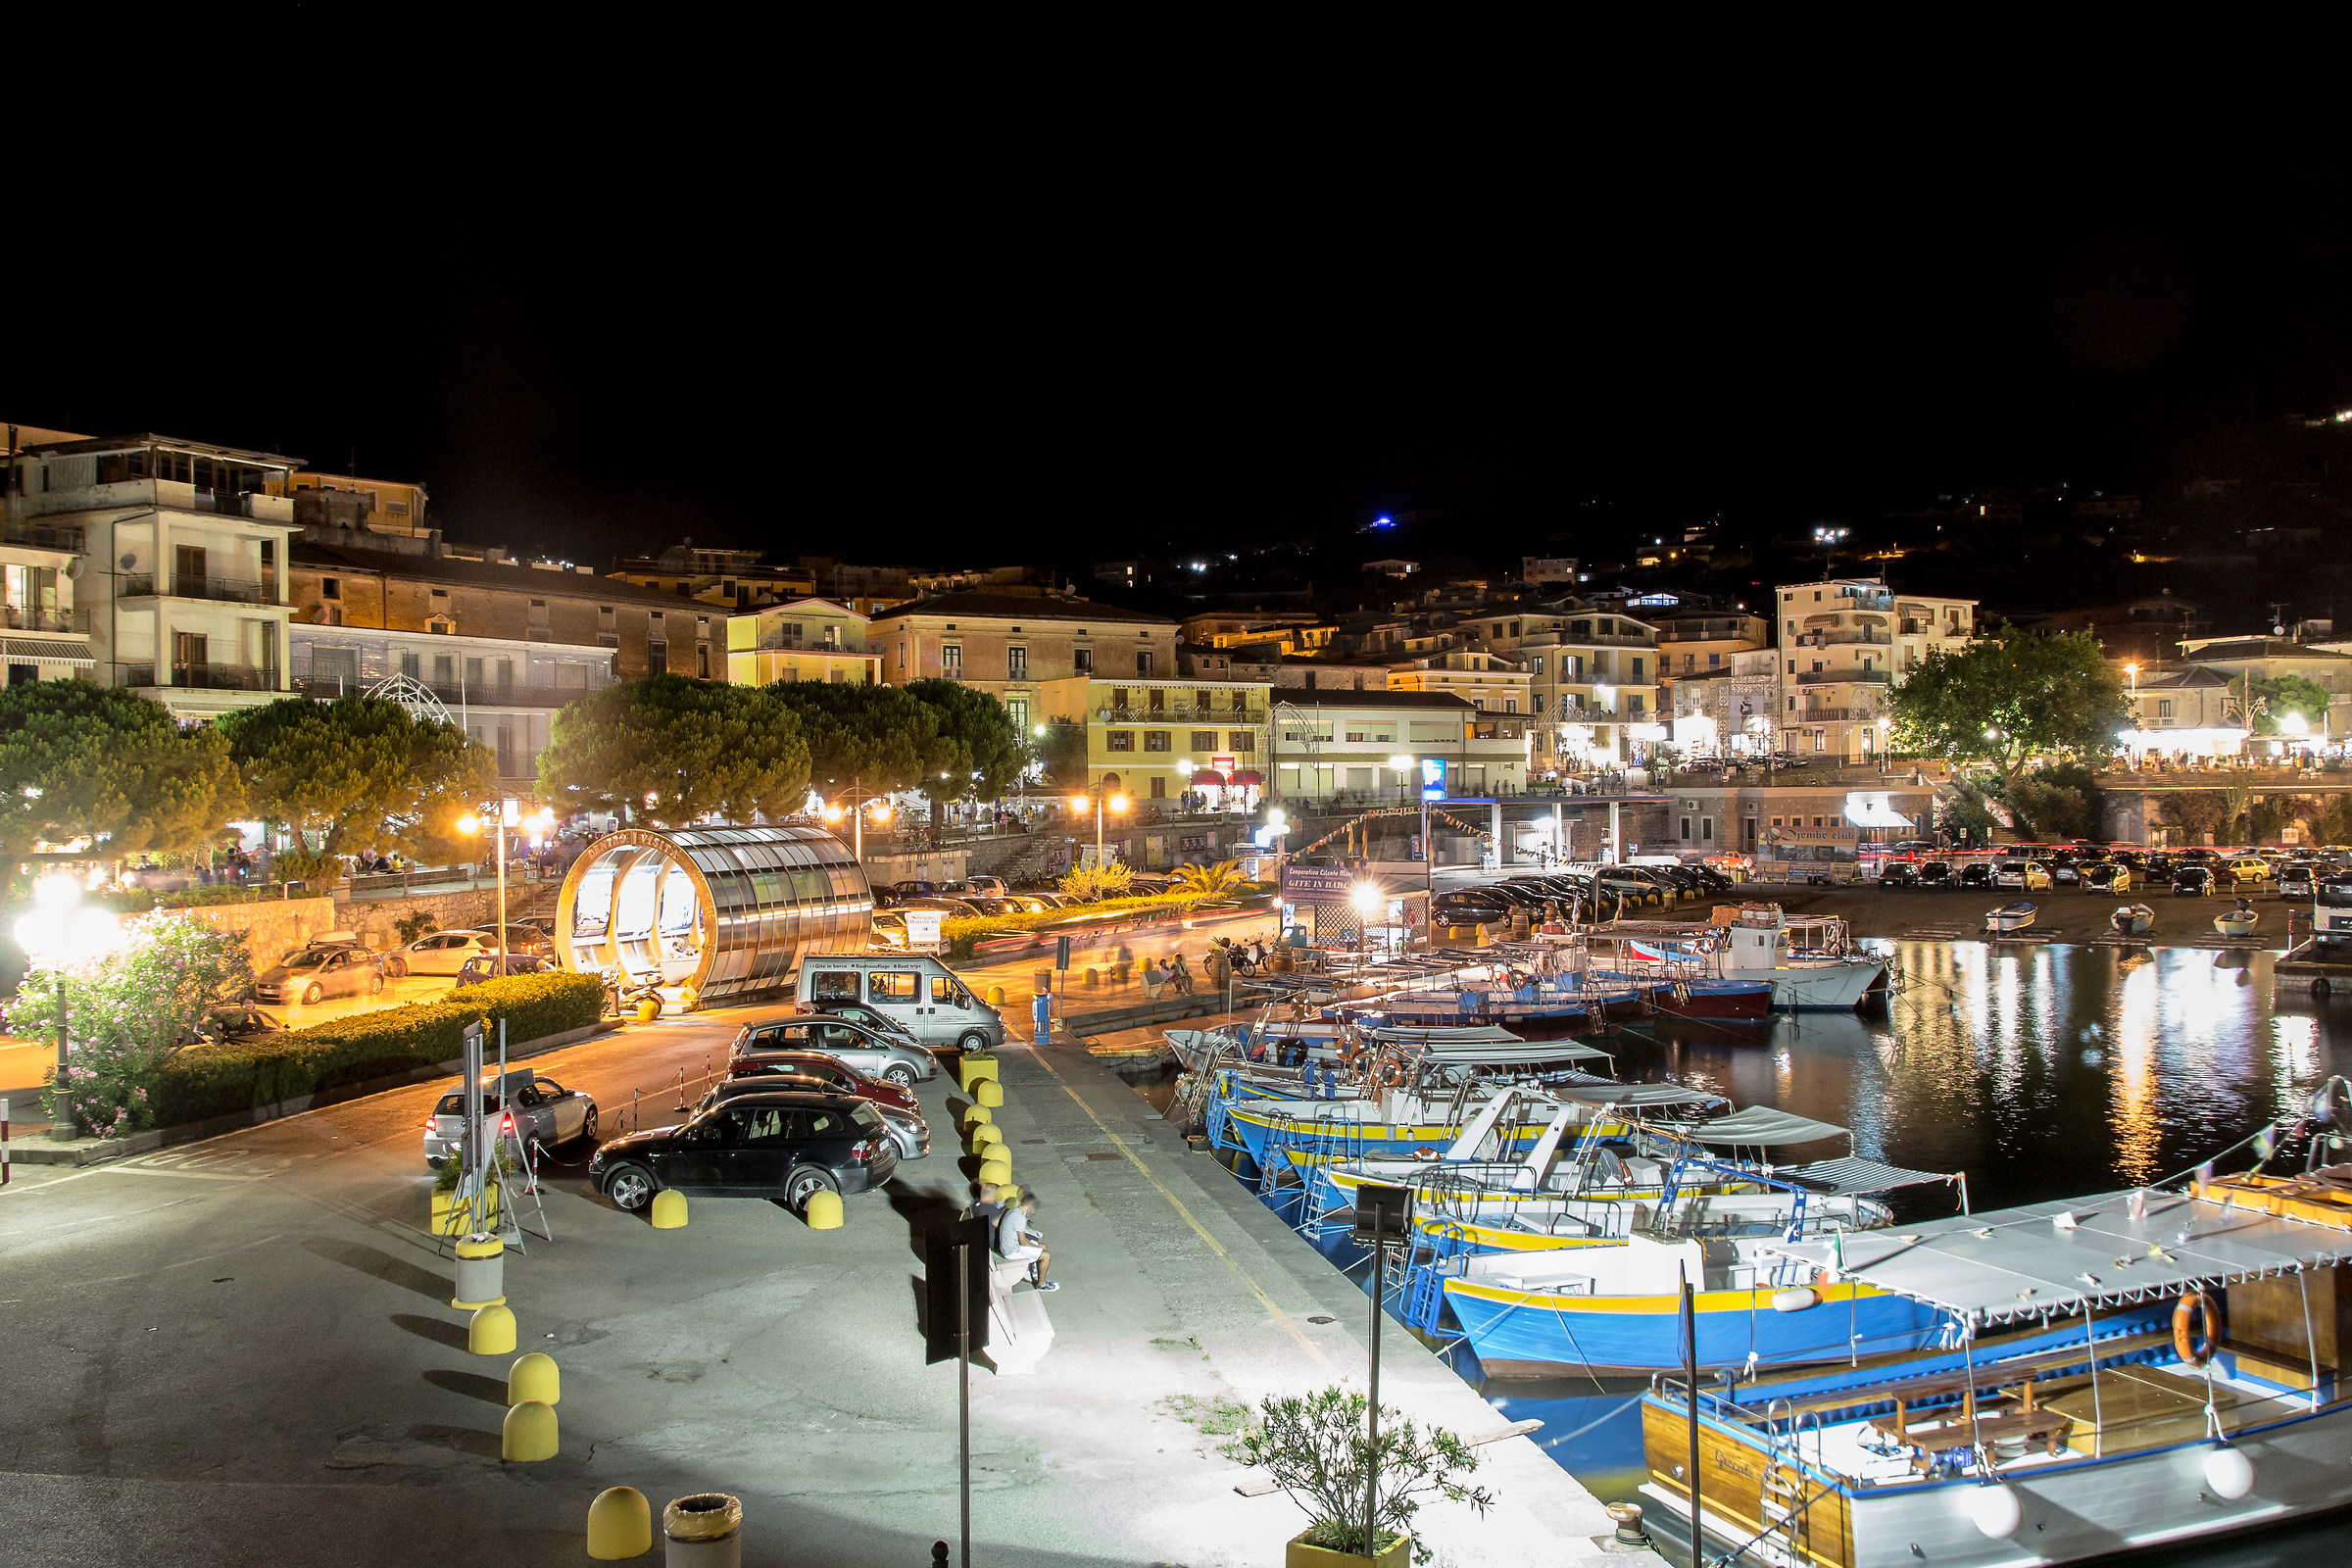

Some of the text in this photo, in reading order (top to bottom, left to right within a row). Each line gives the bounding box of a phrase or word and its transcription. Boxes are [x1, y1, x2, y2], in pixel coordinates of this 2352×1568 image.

[1832, 830, 1854, 840] club
[640, 832, 682, 859] VISITA
[1289, 868, 1319, 876] Cooperativa
